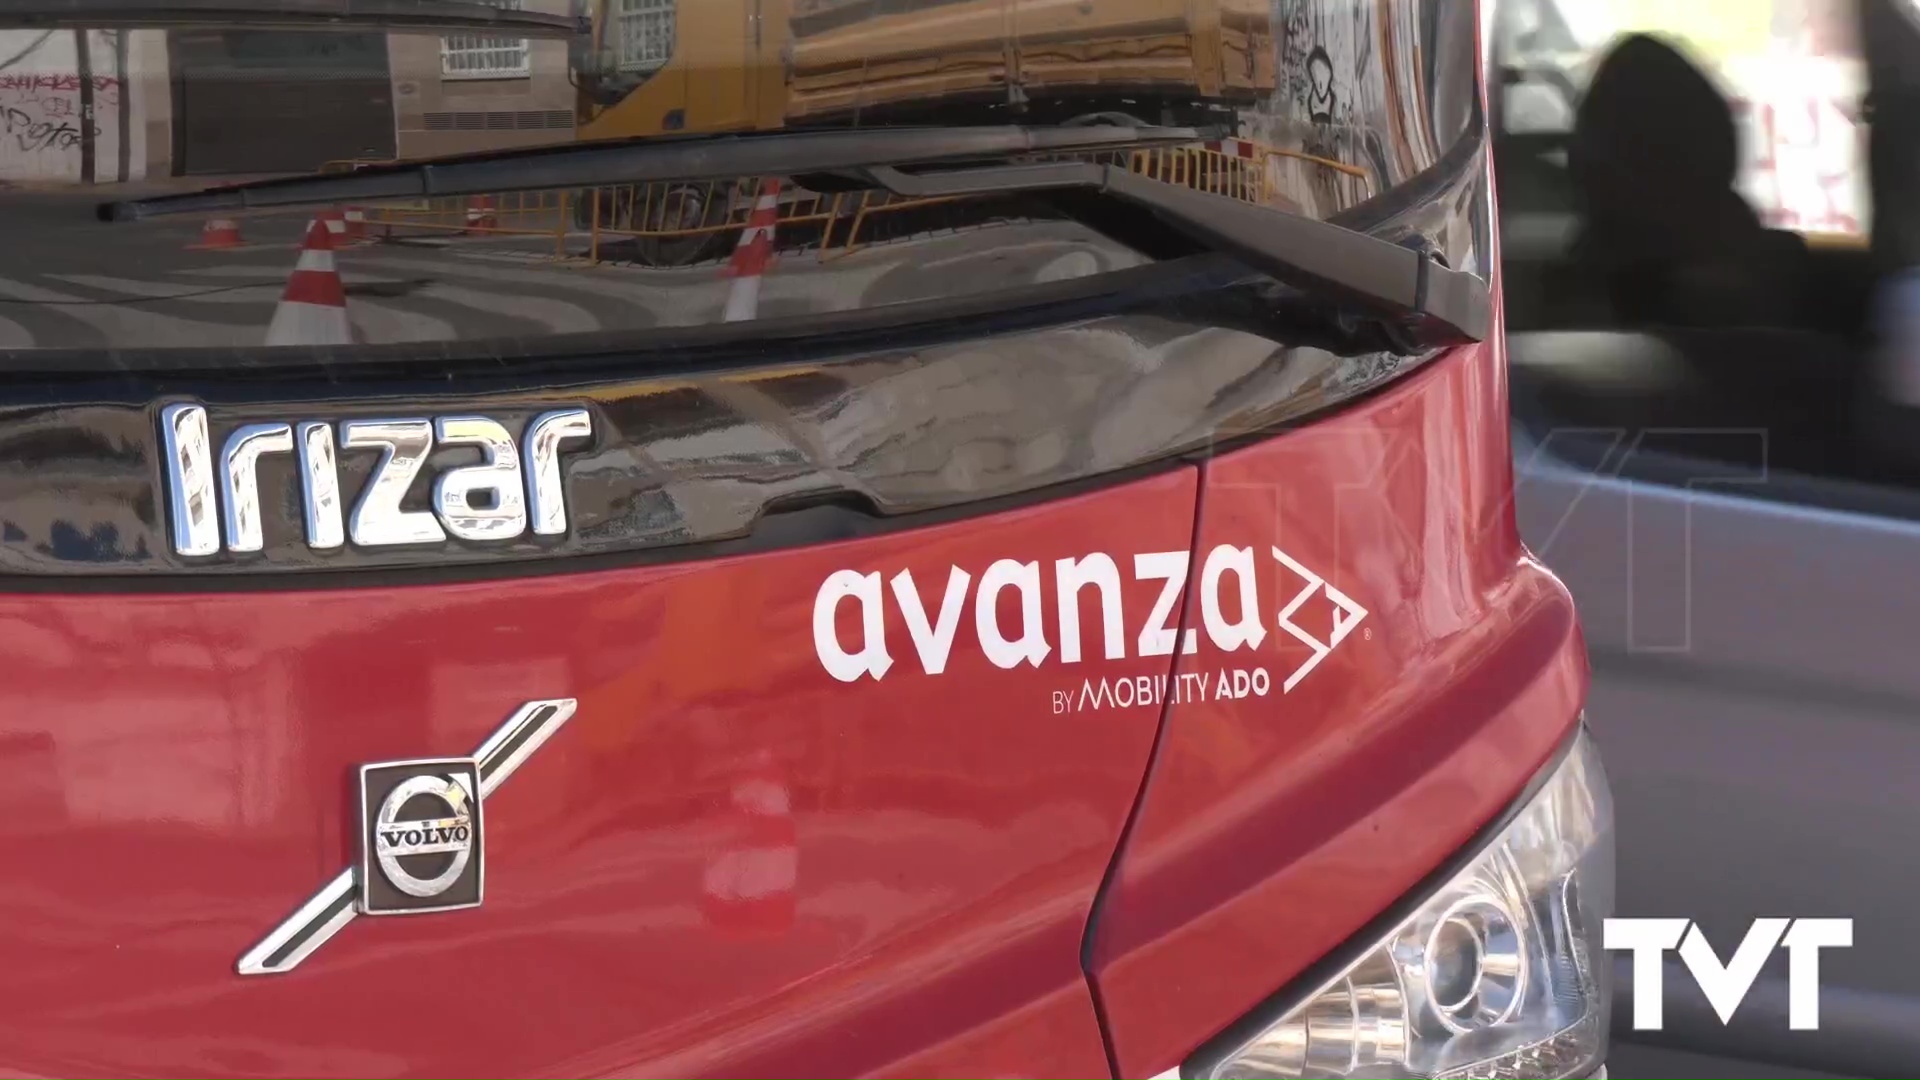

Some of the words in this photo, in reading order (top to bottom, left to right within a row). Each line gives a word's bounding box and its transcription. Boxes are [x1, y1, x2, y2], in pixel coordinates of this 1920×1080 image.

[161, 403, 592, 556] Irizar
[813, 544, 1267, 682] avanza
[1052, 690, 1073, 714] BY
[1078, 672, 1209, 710] MOBILITY
[1215, 668, 1270, 700] ADO
[380, 825, 469, 848] VOLVO
